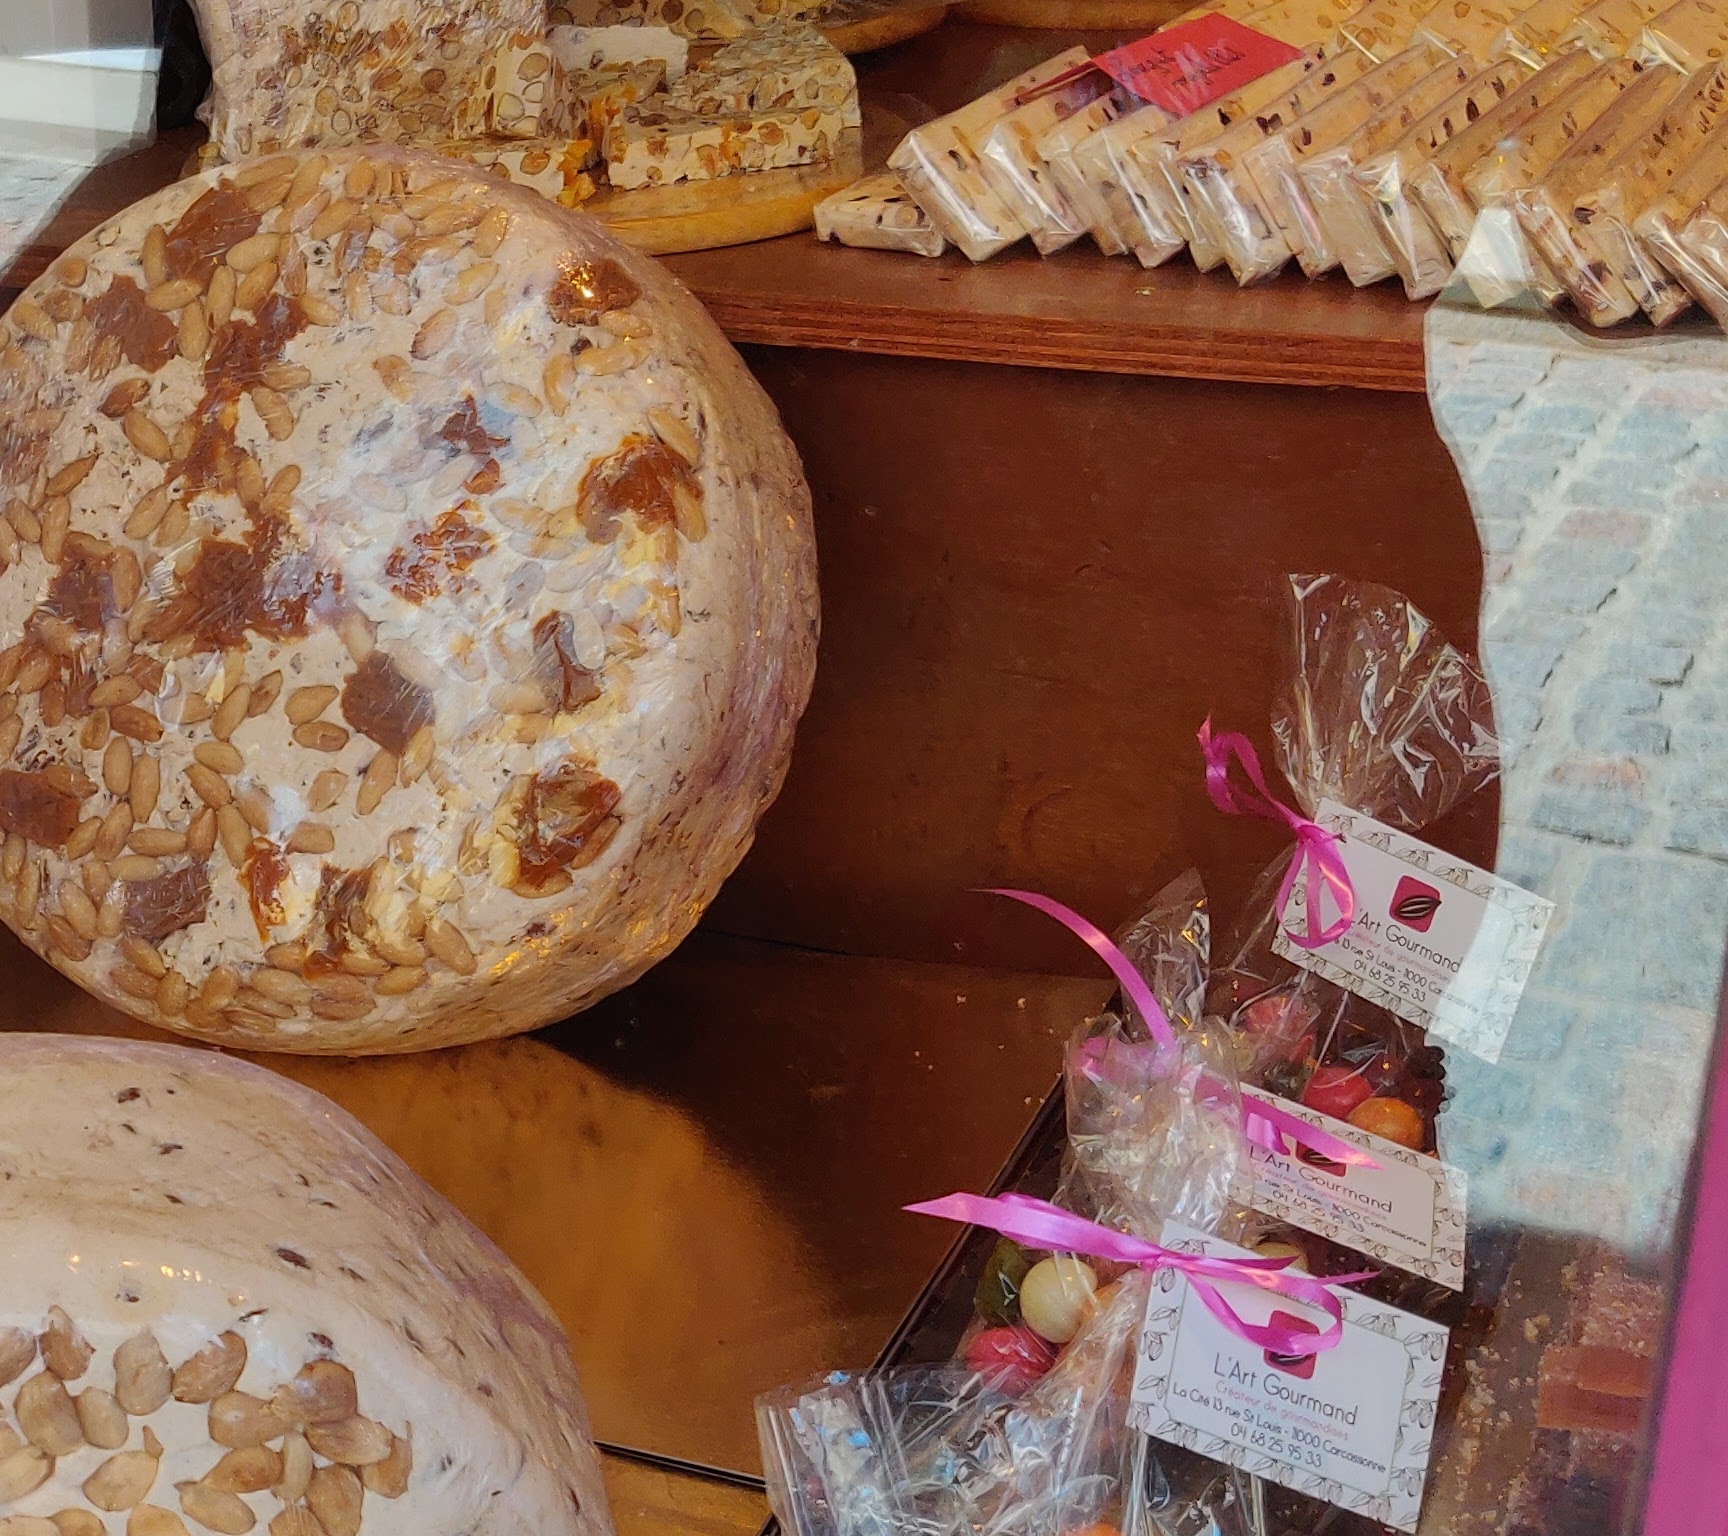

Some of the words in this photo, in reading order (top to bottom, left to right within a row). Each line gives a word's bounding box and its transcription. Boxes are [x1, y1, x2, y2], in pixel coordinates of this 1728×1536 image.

[1350, 908, 1381, 934] 'Art
[1386, 924, 1464, 973] Gourmand
[1368, 965, 1381, 980] 68
[1383, 973, 1395, 988] 25
[1411, 988, 1426, 1003] 33
[1249, 1145, 1290, 1172] L'Art
[1299, 1166, 1392, 1213] Gourmand
[1214, 1352, 1256, 1388] L'Art
[1263, 1372, 1358, 1425] Gourmand
[1173, 1381, 1187, 1398] La
[1225, 1405, 1240, 1418] rue
[1323, 1439, 1386, 1473] Carcassonne
[1230, 1423, 1247, 1440] 04
[1250, 1429, 1266, 1447] 68
[1267, 1436, 1283, 1453] 25
[1288, 1444, 1302, 1460] 95
[1305, 1450, 1322, 1468] 33
